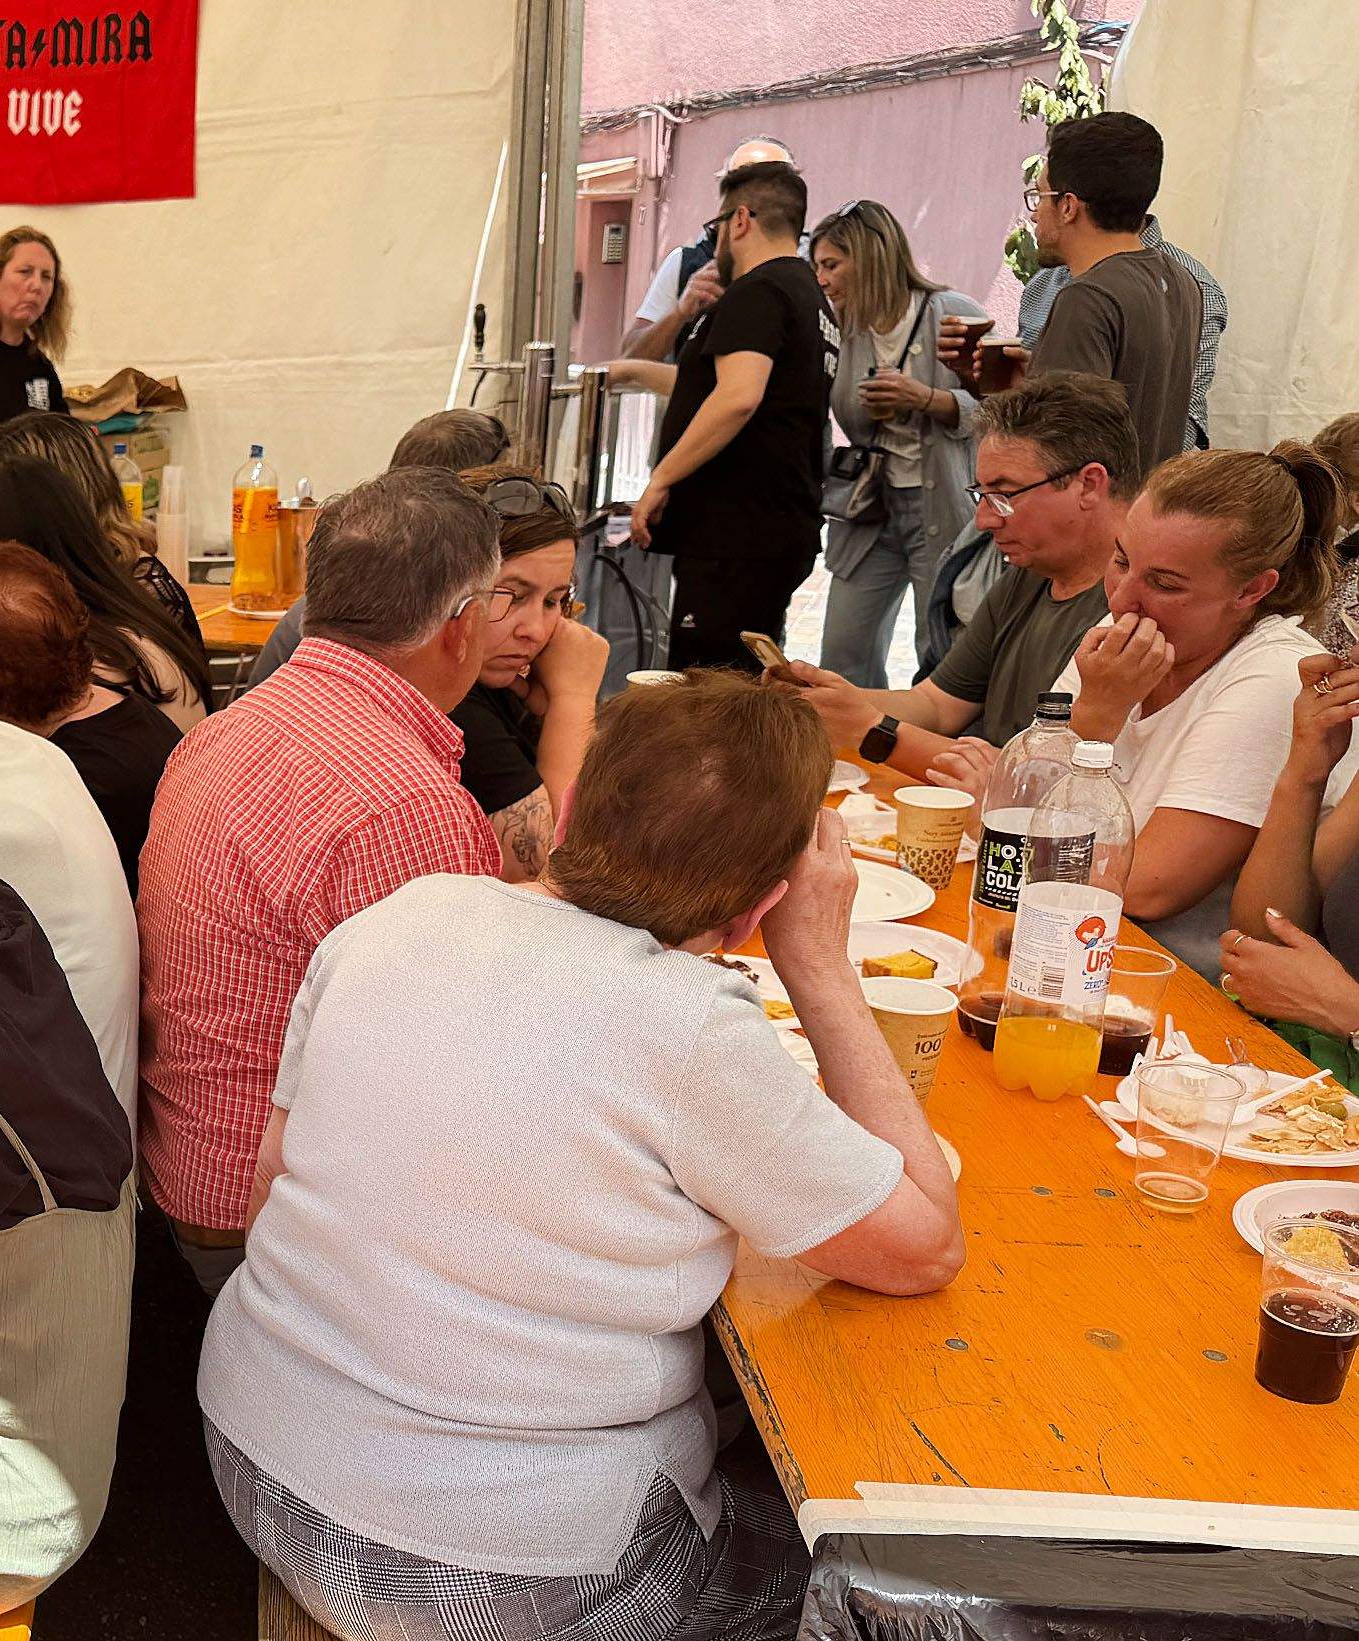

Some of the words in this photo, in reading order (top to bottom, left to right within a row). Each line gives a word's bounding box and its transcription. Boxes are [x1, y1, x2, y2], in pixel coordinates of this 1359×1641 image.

[50, 10, 152, 67] MIRA
[7, 88, 83, 137] VIVE
[987, 855, 1015, 874] LA
[914, 1036, 944, 1055] 100
